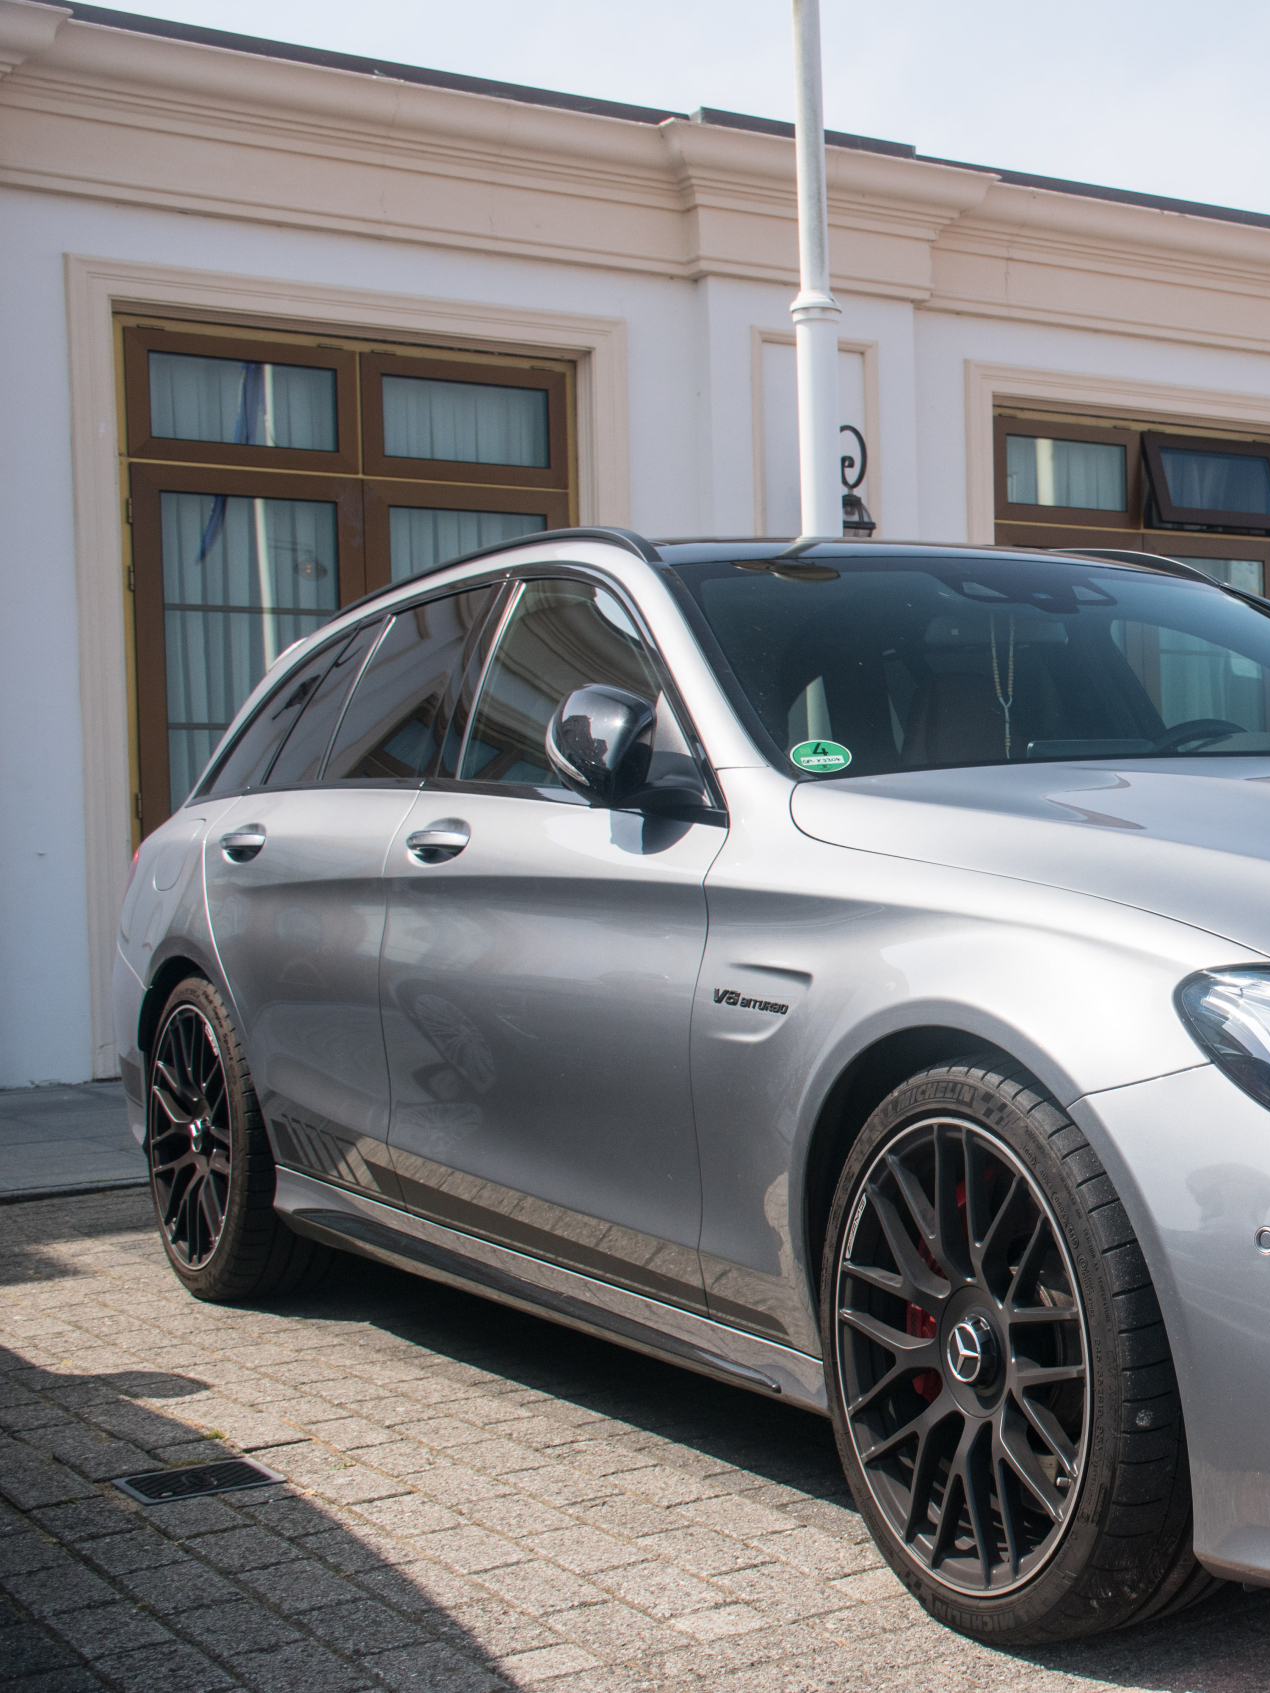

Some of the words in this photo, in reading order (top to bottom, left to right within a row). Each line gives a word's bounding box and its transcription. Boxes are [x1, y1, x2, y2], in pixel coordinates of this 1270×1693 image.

[813, 743, 828, 756] 4
[713, 987, 741, 1007] V8
[740, 997, 789, 1015] BITURBO
[897, 1081, 976, 1112] MICHELIN
[934, 1602, 1016, 1632] MICHELIN
